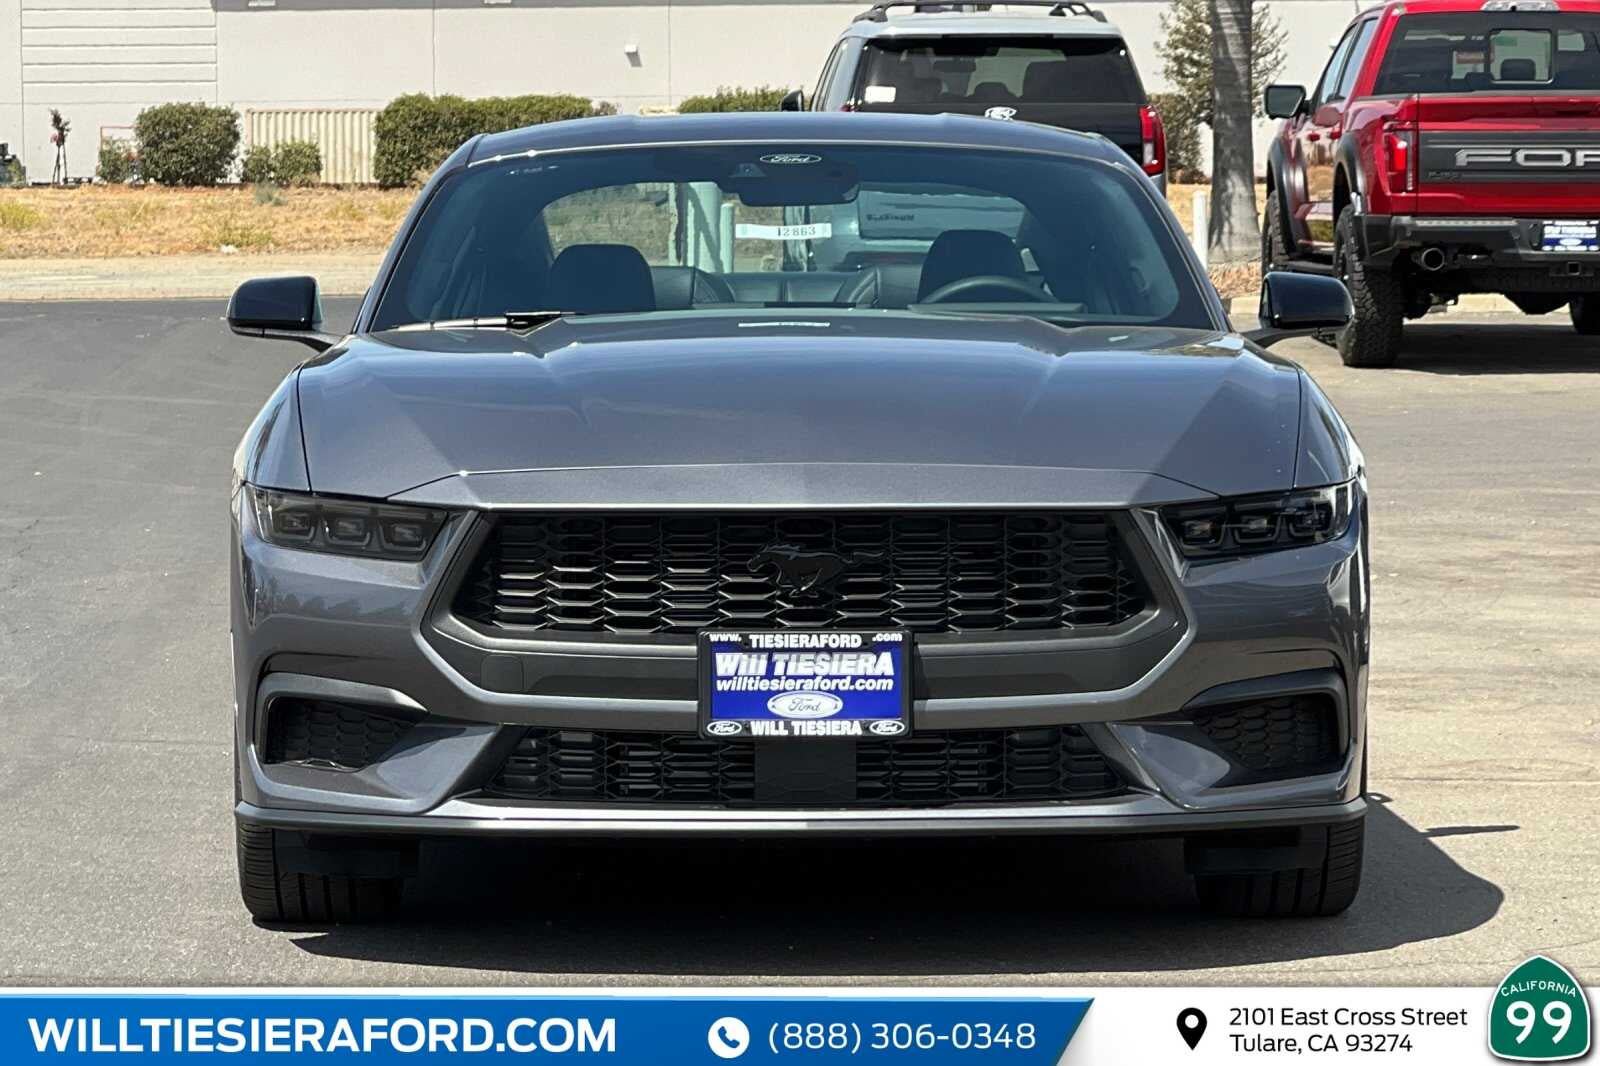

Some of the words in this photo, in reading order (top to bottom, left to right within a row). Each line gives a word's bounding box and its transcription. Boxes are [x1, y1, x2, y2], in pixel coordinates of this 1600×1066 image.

[777, 226, 816, 237] 12863
[709, 633, 742, 642] www.
[749, 634, 862, 648] TIESIERAFORD
[872, 633, 903, 642] .com
[772, 652, 894, 676] TIESIERA
[716, 676, 894, 691] willtiesieraford.com
[750, 721, 788, 736] WILL
[791, 721, 862, 736] TIESIERA
